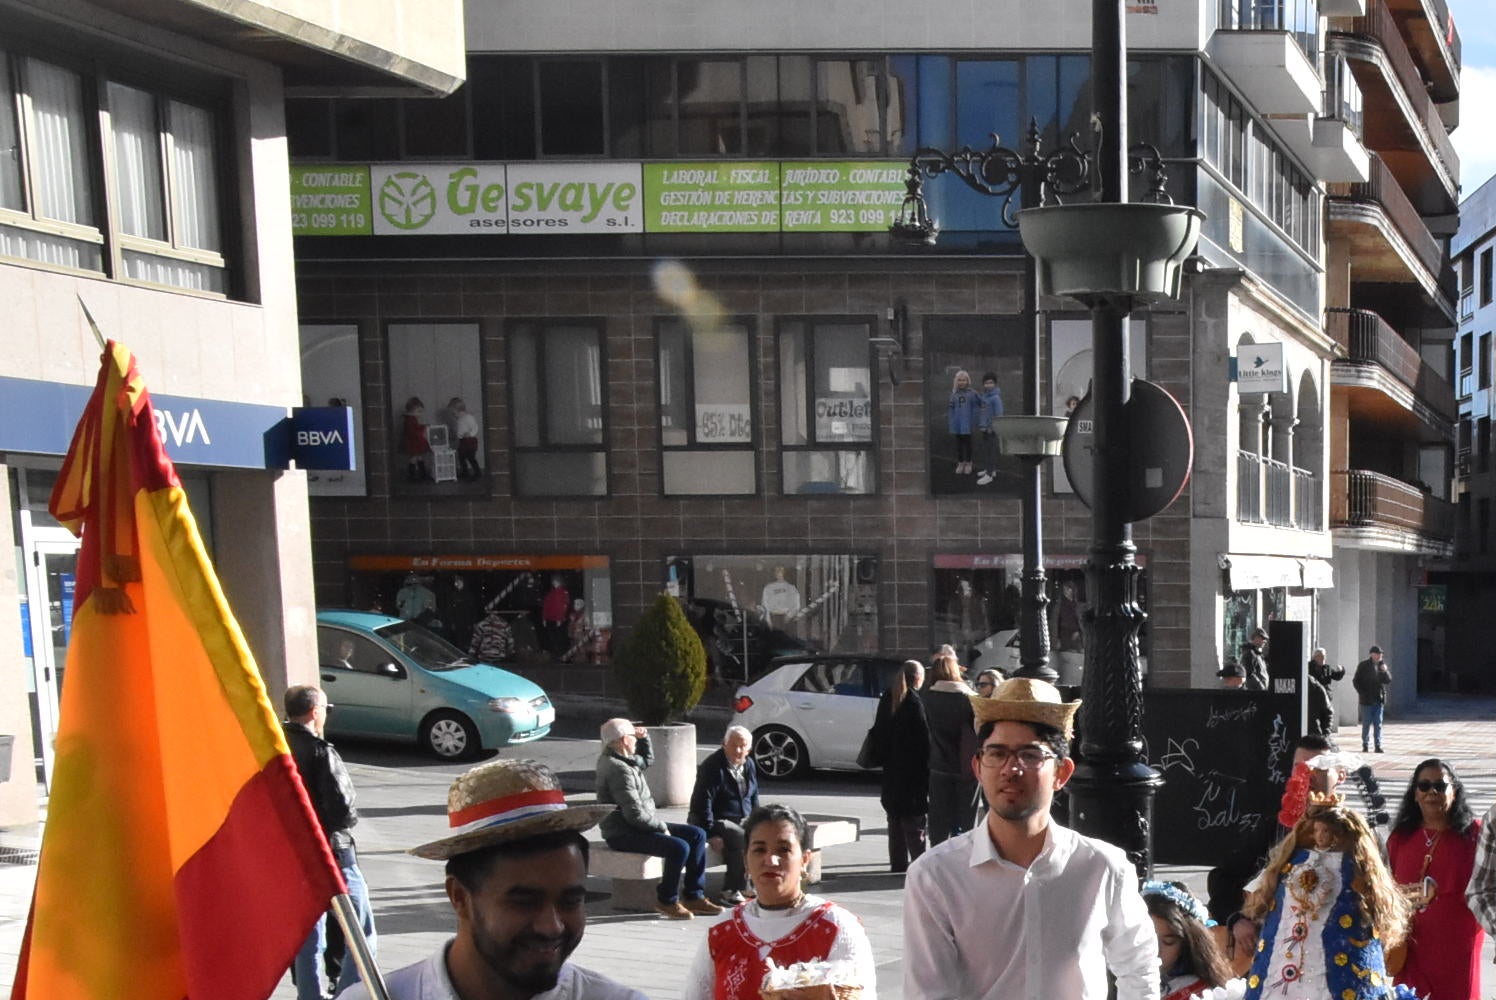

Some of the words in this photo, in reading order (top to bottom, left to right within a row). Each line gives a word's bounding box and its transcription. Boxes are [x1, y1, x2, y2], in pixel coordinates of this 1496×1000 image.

[303, 172, 364, 187] CONTABLE
[662, 170, 719, 186] LABORAL
[730, 169, 771, 184] FISCAL
[447, 167, 636, 223] Gesvaye
[715, 190, 732, 205] DE
[806, 190, 815, 205] Y
[816, 189, 906, 205] SUBVENCIONES
[312, 213, 336, 228] 099
[340, 213, 365, 227] 119
[469, 217, 568, 227] asesores
[606, 216, 635, 227] s.l.
[661, 211, 759, 228] DECLARACIONES
[761, 211, 778, 225] DE
[785, 210, 822, 228] RENTA
[830, 209, 855, 225] 923
[859, 209, 885, 225] 099
[816, 400, 871, 418] Outlet
[152, 408, 211, 448] BVA
[297, 430, 344, 446] BBVA
[1274, 678, 1296, 694] NAKAR
